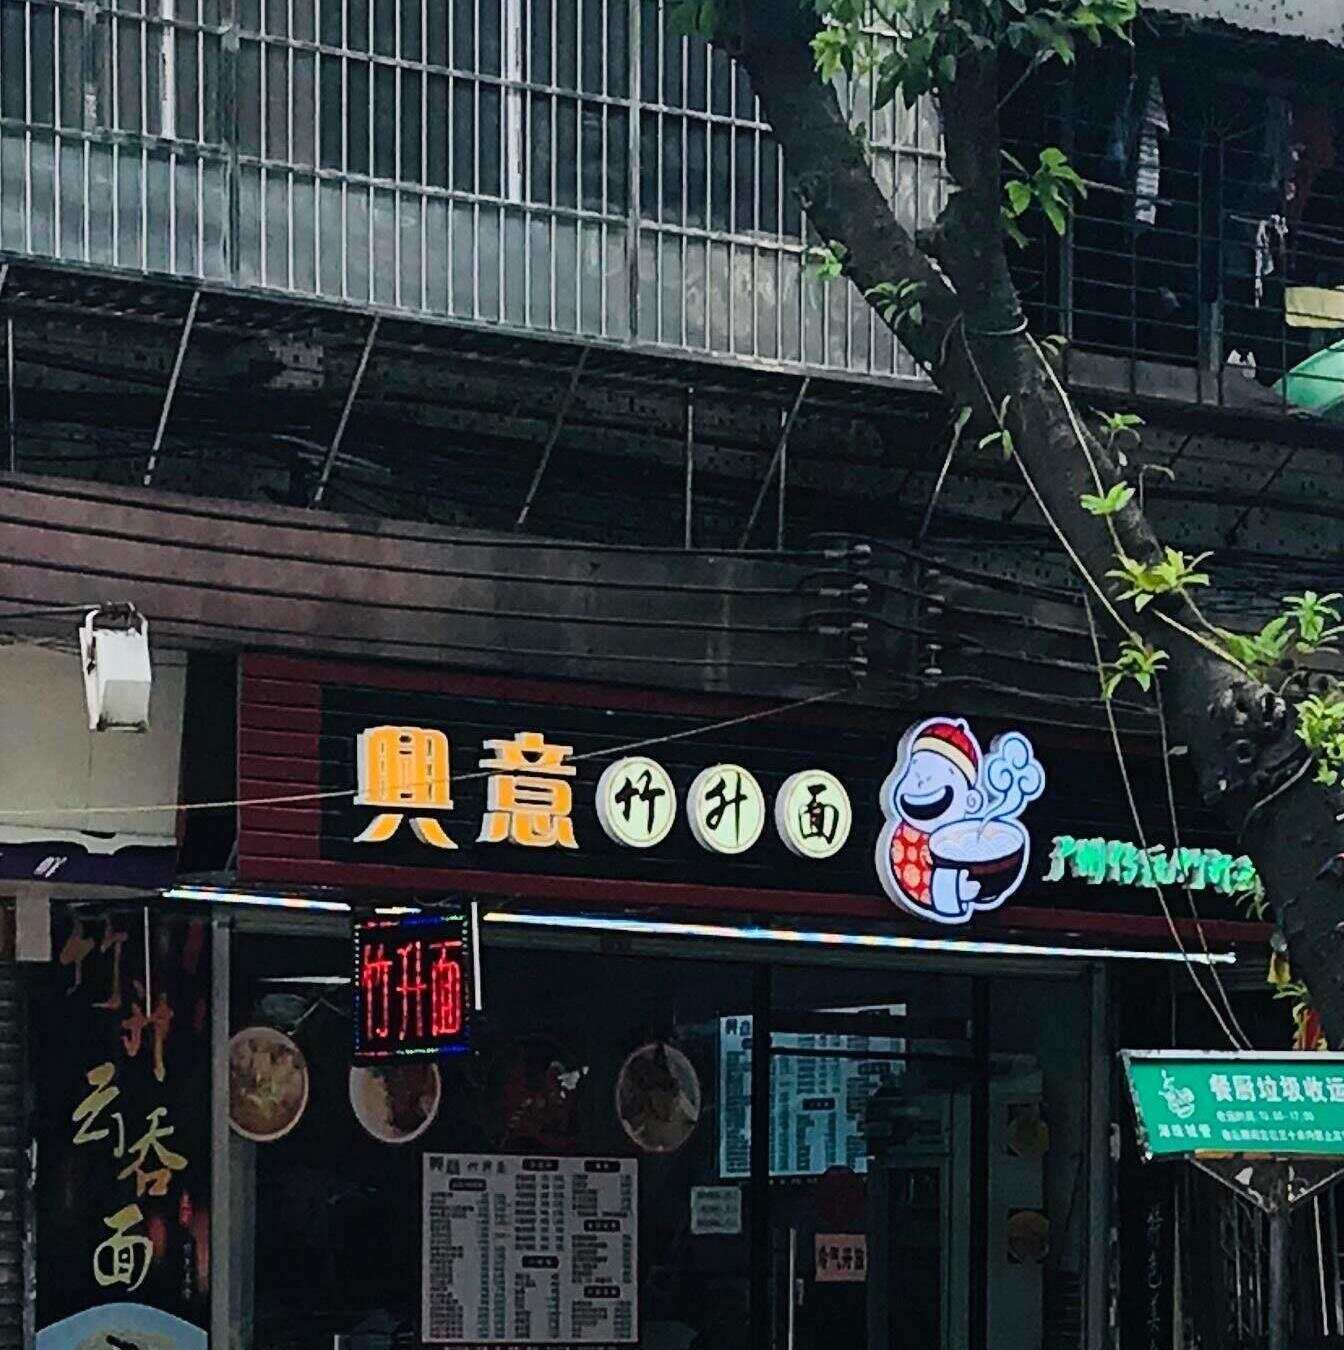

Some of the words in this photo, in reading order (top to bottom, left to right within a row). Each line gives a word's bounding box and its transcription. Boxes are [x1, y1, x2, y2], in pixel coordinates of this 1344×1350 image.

[353, 724, 580, 850] 興意
[606, 762, 846, 850] 竹升面
